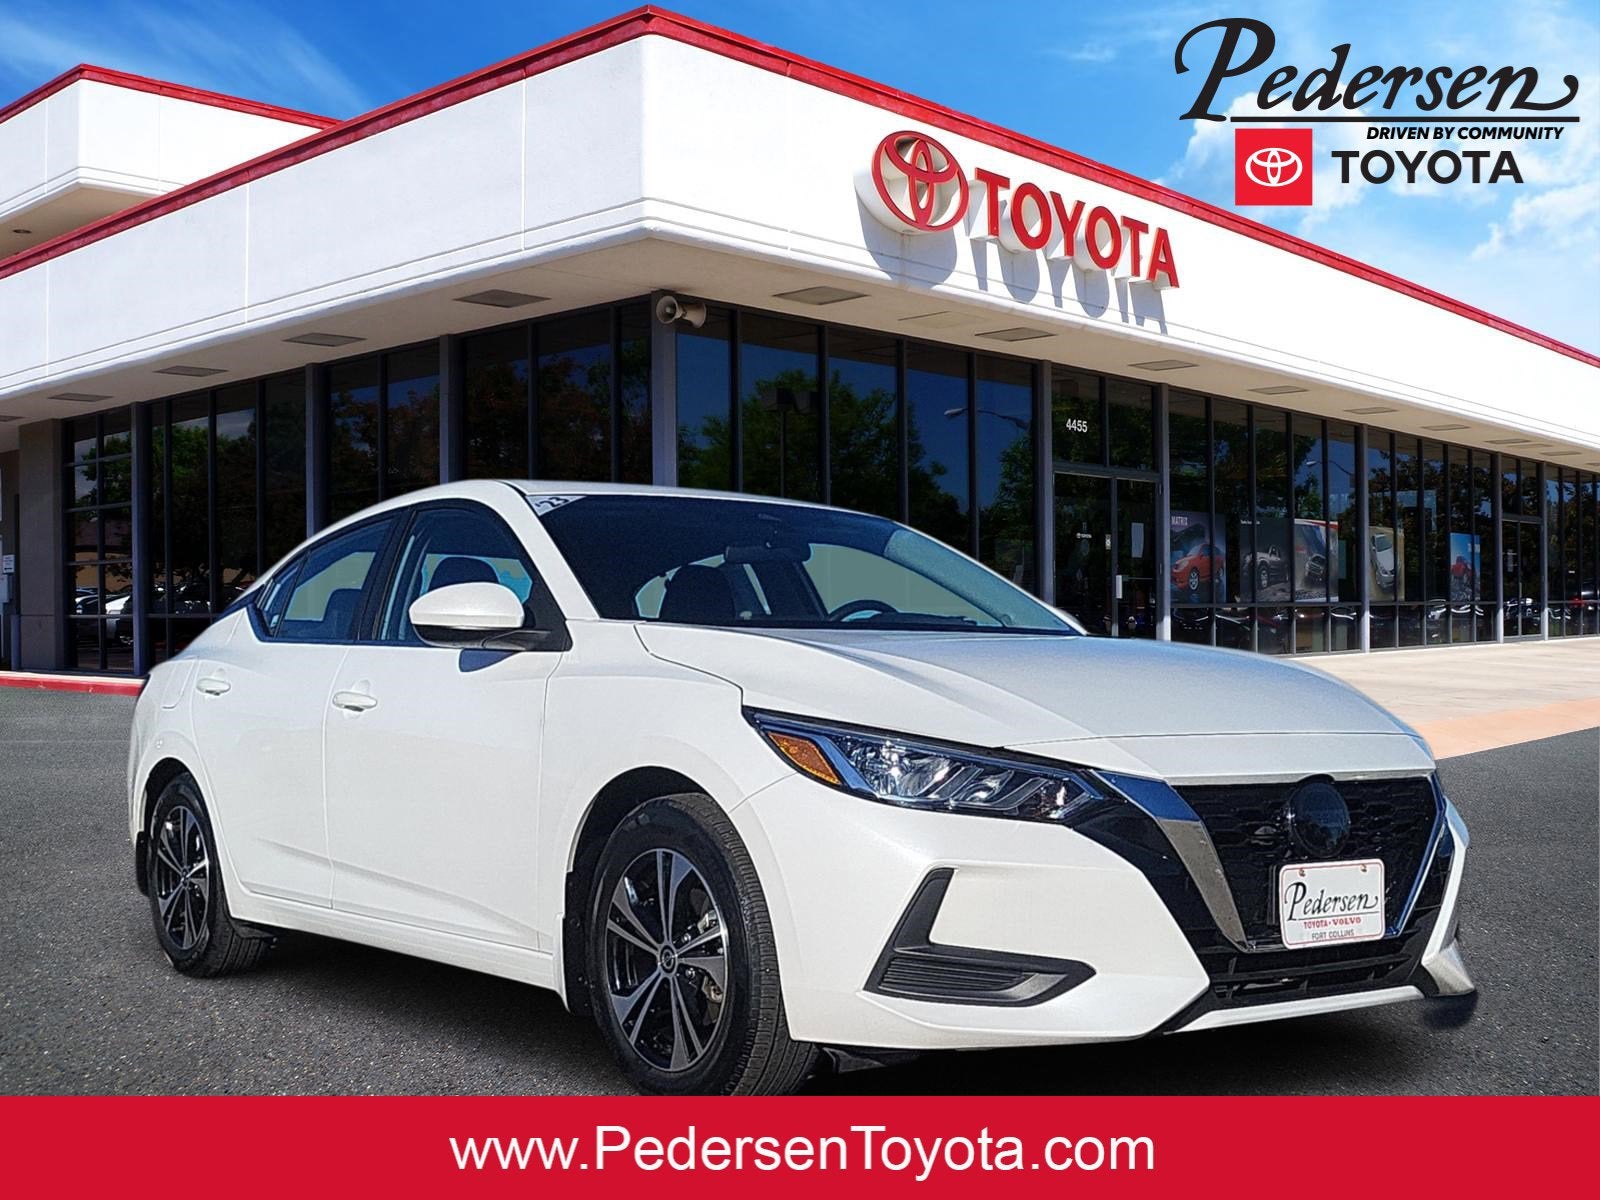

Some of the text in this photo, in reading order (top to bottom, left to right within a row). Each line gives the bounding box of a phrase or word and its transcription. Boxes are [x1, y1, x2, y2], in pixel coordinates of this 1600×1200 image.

[975, 167, 1180, 288] TOYOTA
[1066, 418, 1088, 433] 4455
[1284, 881, 1379, 922] Pedersen
[1303, 916, 1362, 929] TOYOTA VOLVO
[1311, 929, 1355, 940] FORT COLLINS
